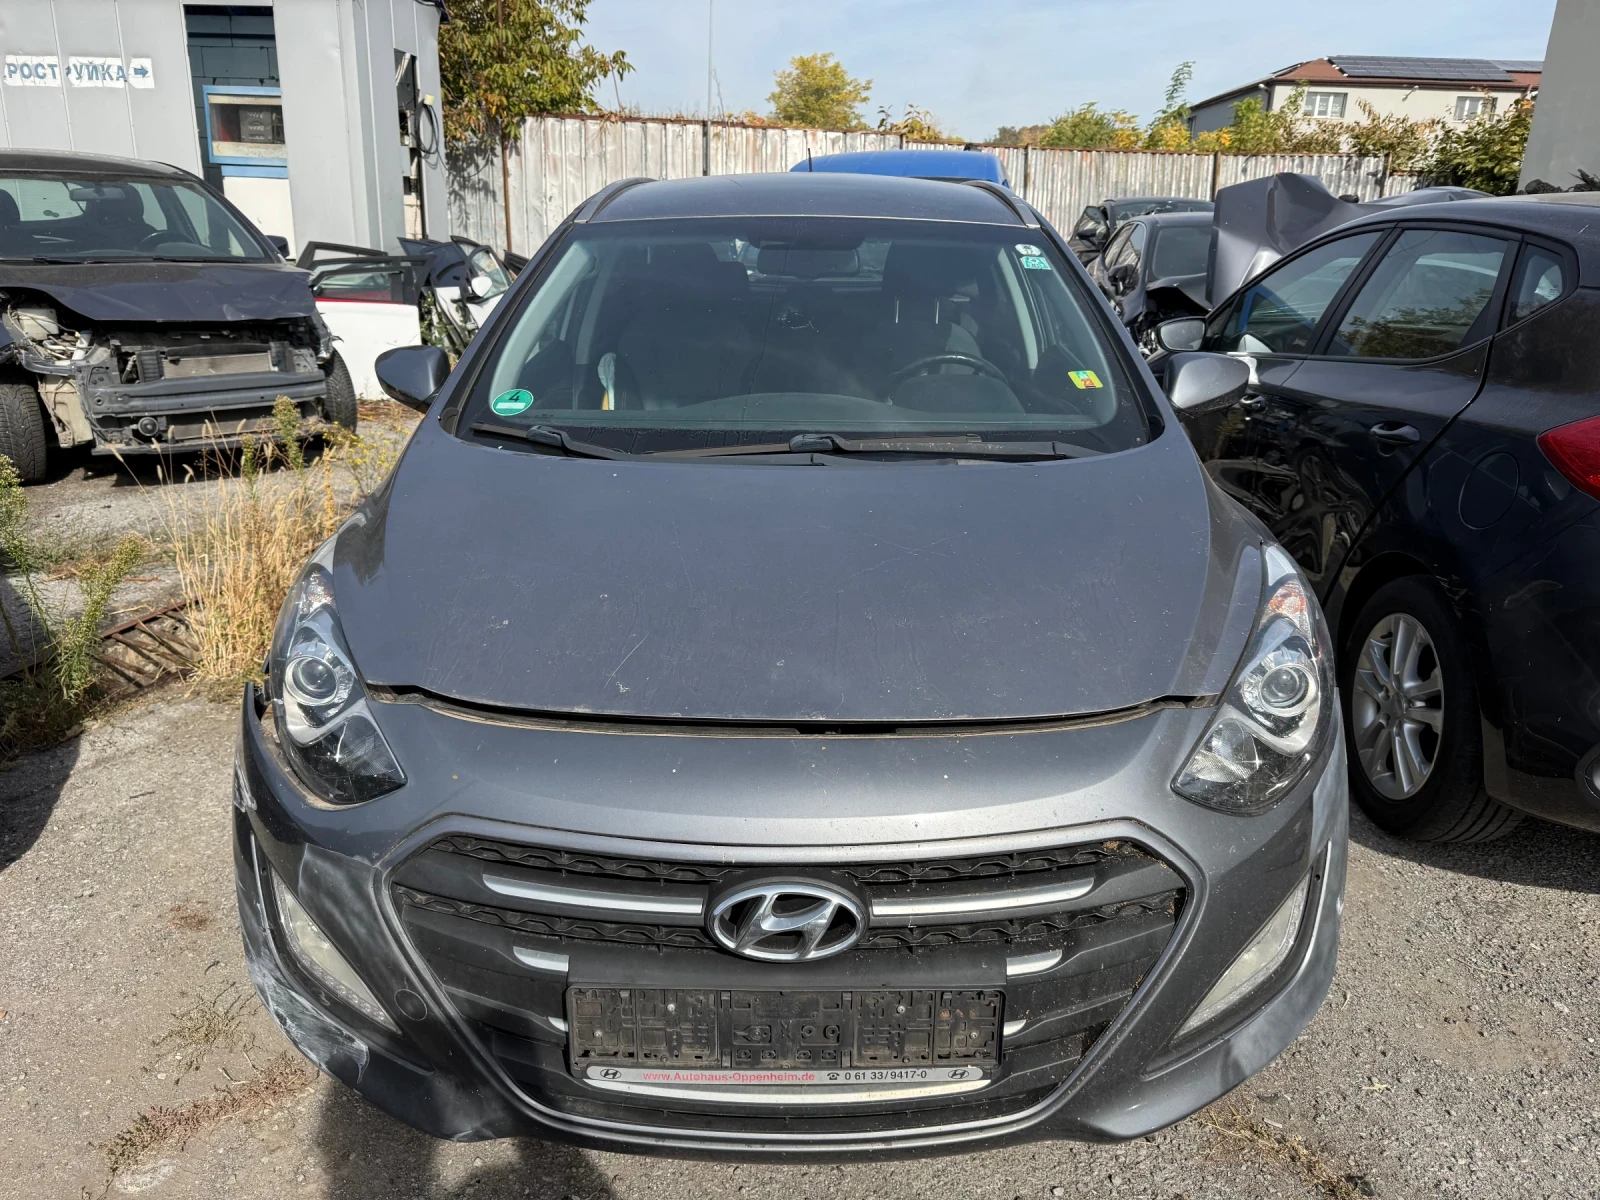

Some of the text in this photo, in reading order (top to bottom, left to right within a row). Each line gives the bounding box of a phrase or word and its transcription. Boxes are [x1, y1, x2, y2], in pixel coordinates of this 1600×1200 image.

[508, 390, 521, 403] 4
[642, 1072, 815, 1082] www.Autohaus-Oppenheim.de
[844, 1072, 851, 1080] 0
[854, 1072, 866, 1080] 61
